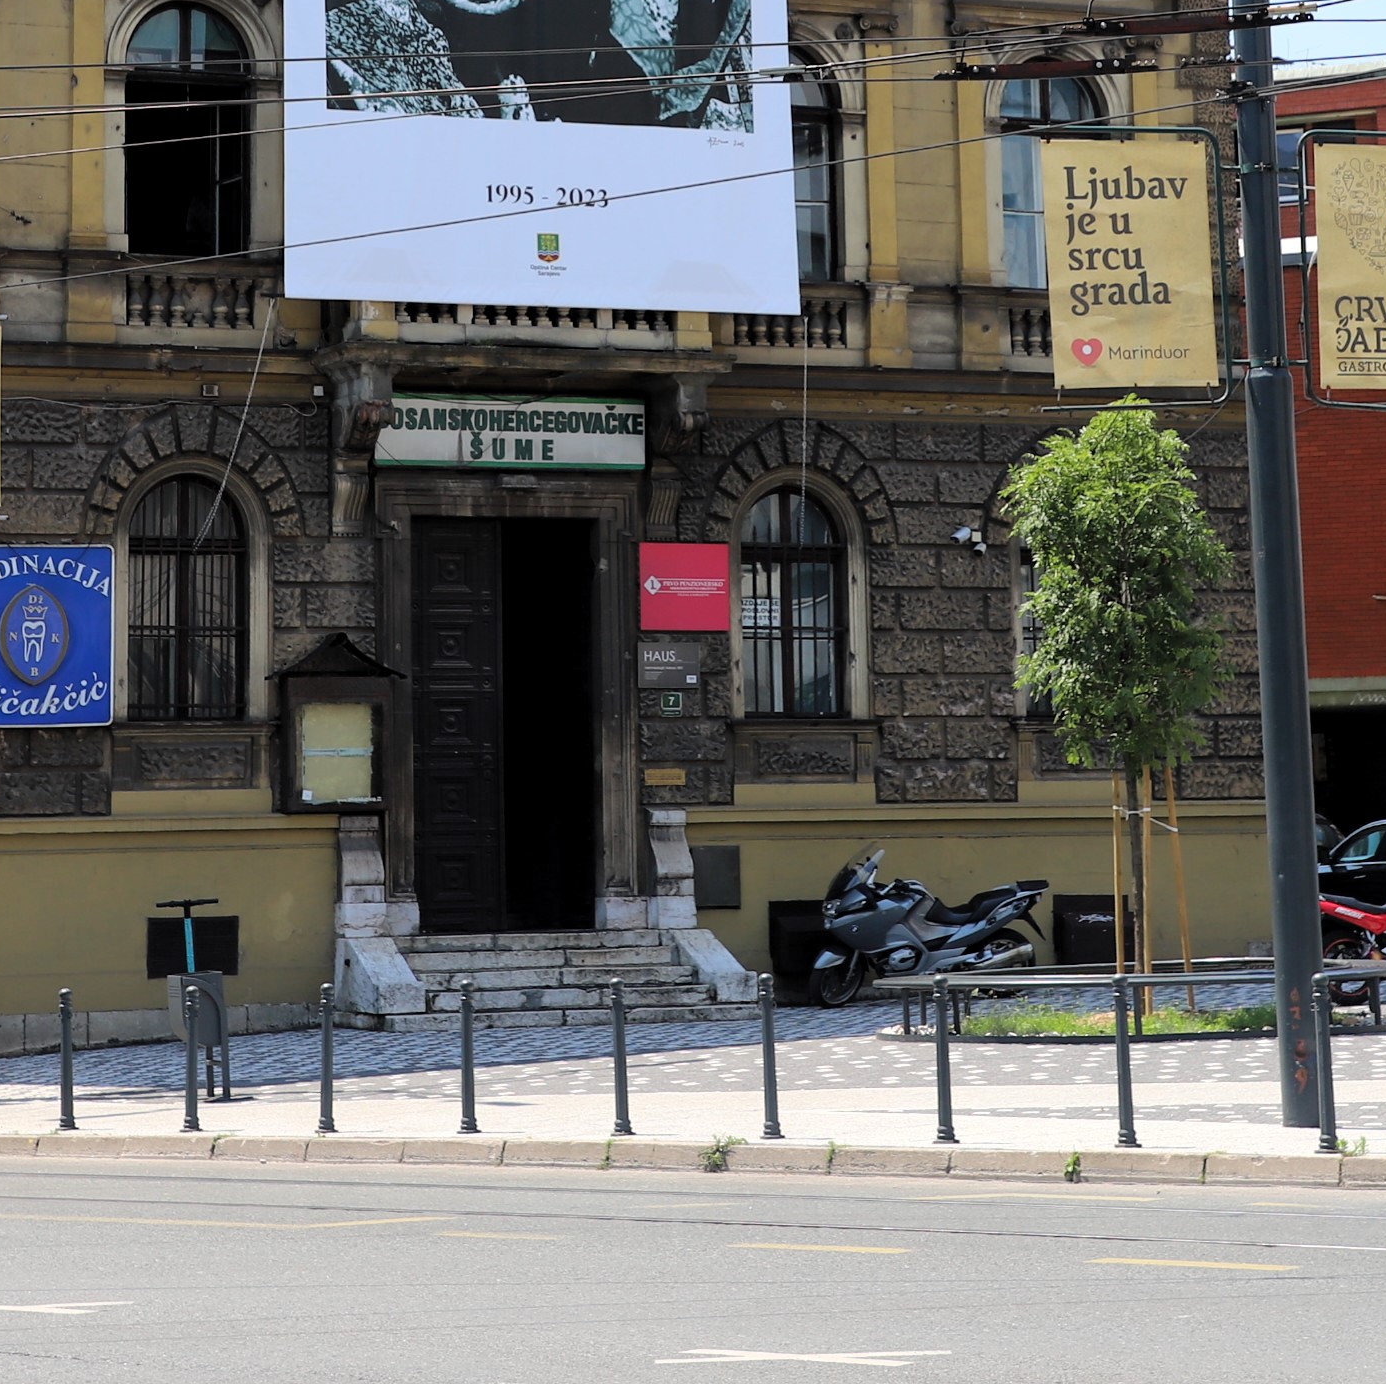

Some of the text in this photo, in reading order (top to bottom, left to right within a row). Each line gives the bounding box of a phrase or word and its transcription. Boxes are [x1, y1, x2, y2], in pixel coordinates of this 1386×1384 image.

[486, 184, 534, 205] 1995
[556, 187, 609, 208] 2023
[1063, 165, 1188, 209] Ljubav
[1065, 204, 1133, 245] je u
[1068, 246, 1145, 271] srcu
[1070, 271, 1172, 316] grada
[1108, 343, 1191, 361] Marinduor
[380, 406, 644, 435] OSANSKOHERCEGOVAČKE
[470, 432, 554, 460] ŠUME
[9, 632, 60, 643] N K
[644, 650, 676, 662] HAUS
[30, 668, 39, 677] B
[668, 697, 675, 706] 7
